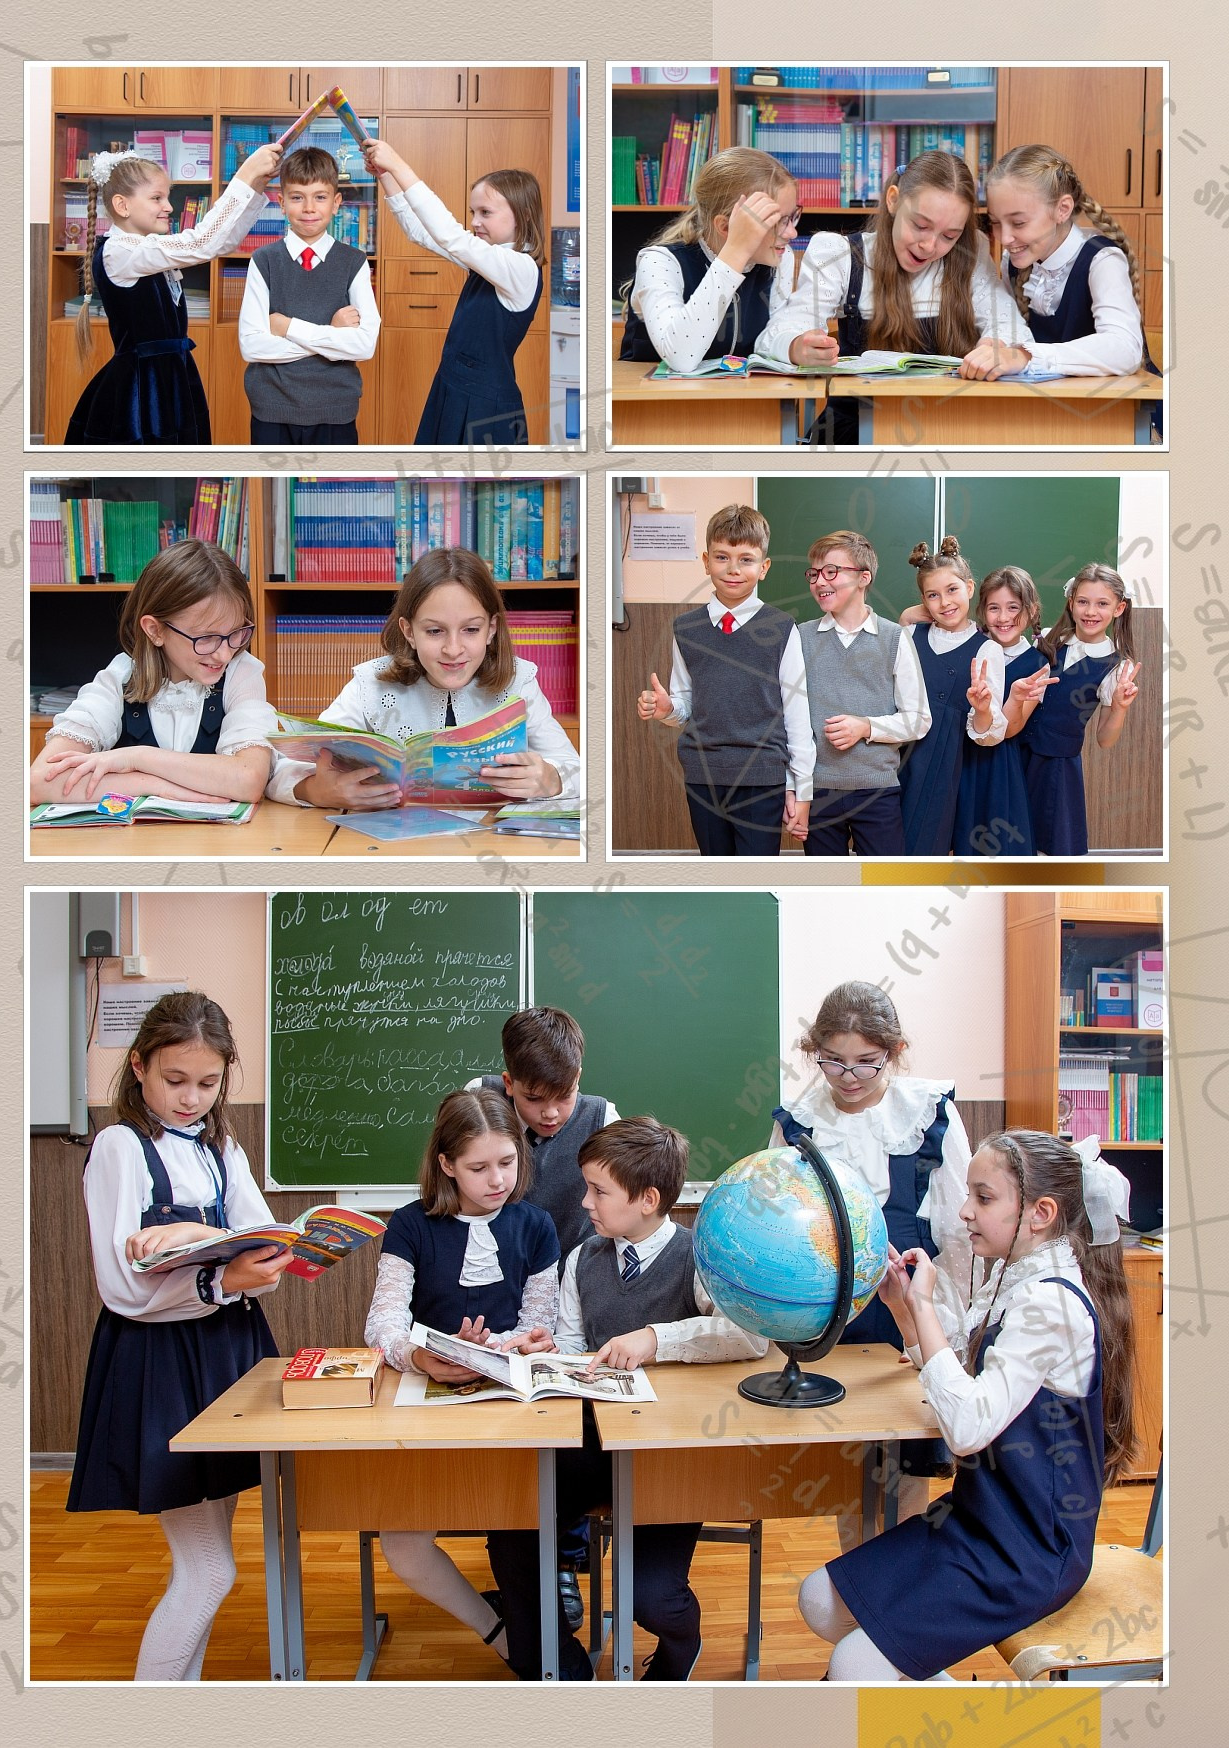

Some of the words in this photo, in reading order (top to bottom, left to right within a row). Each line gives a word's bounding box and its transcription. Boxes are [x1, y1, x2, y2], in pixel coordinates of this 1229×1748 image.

[454, 780, 471, 791] 4
[409, 898, 448, 916] ет
[435, 949, 514, 978] прячется
[432, 975, 507, 995] холодов
[416, 1016, 442, 1027] на
